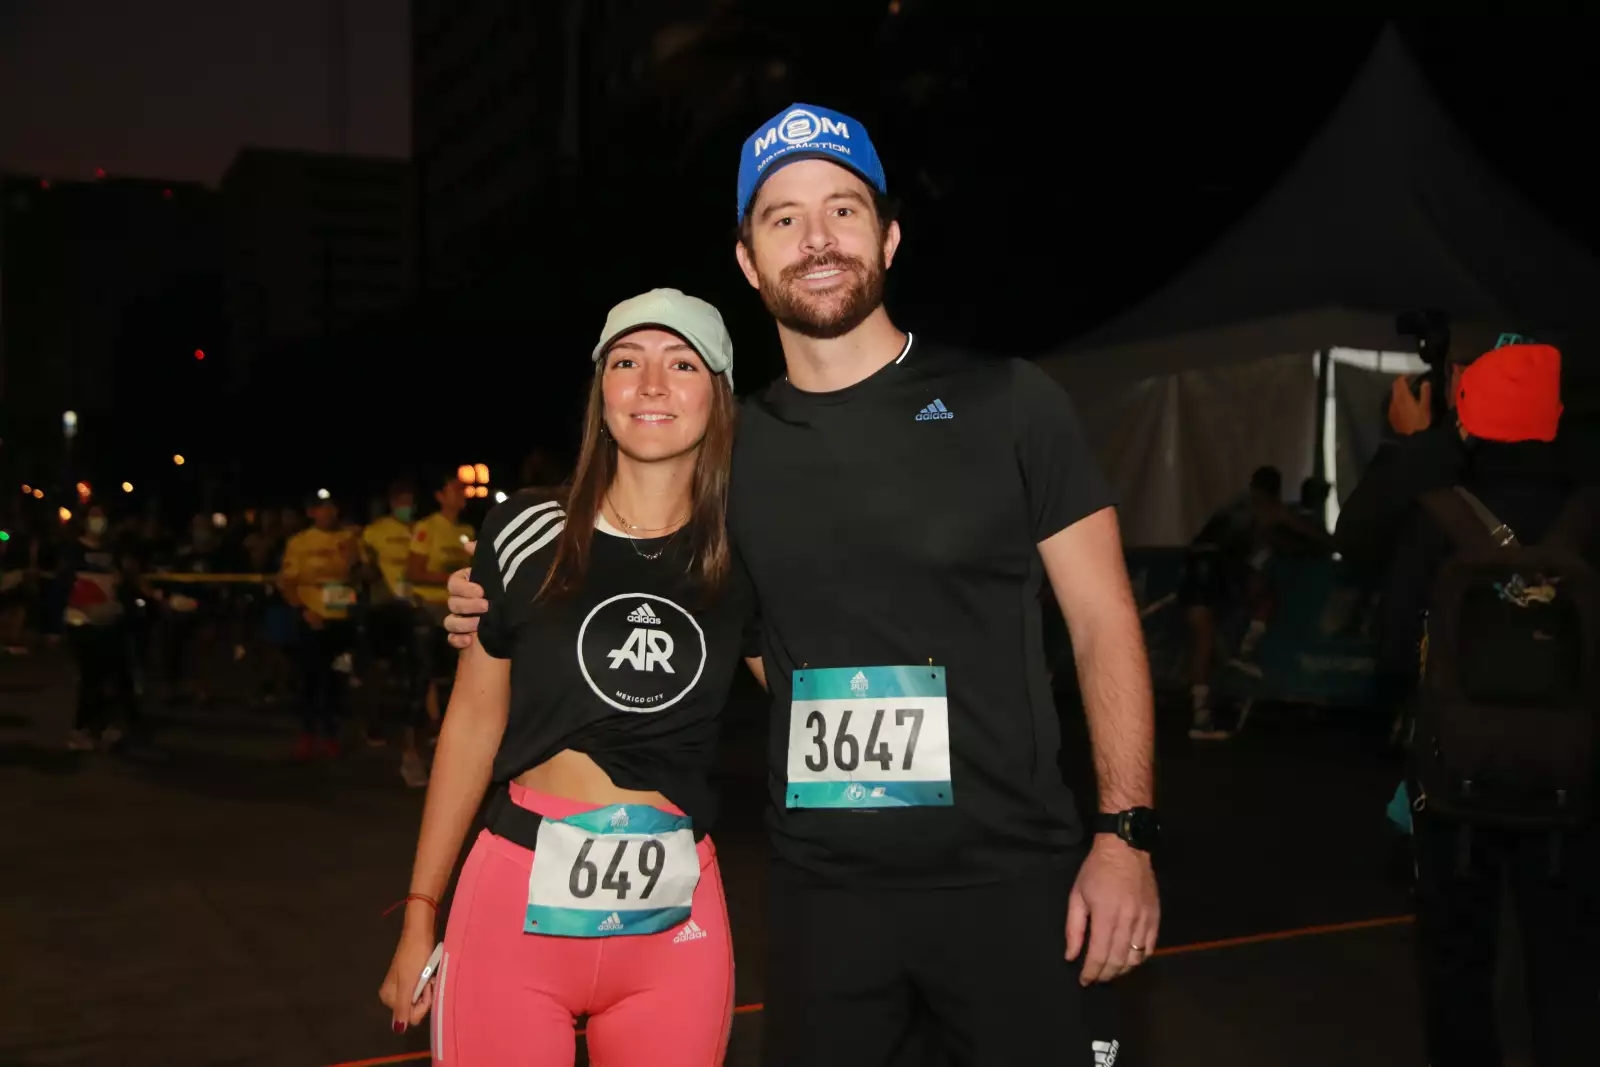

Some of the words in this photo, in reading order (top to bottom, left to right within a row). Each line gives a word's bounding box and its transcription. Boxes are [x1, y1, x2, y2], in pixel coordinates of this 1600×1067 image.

[915, 411, 954, 421] adidas
[627, 614, 662, 625] adidas
[607, 627, 676, 674] AR
[615, 690, 645, 703] MEXICO
[646, 692, 664, 703] CITY
[804, 708, 924, 773] 3647
[568, 837, 666, 900] 649
[597, 920, 624, 932] adidas
[673, 929, 707, 944] adidas
